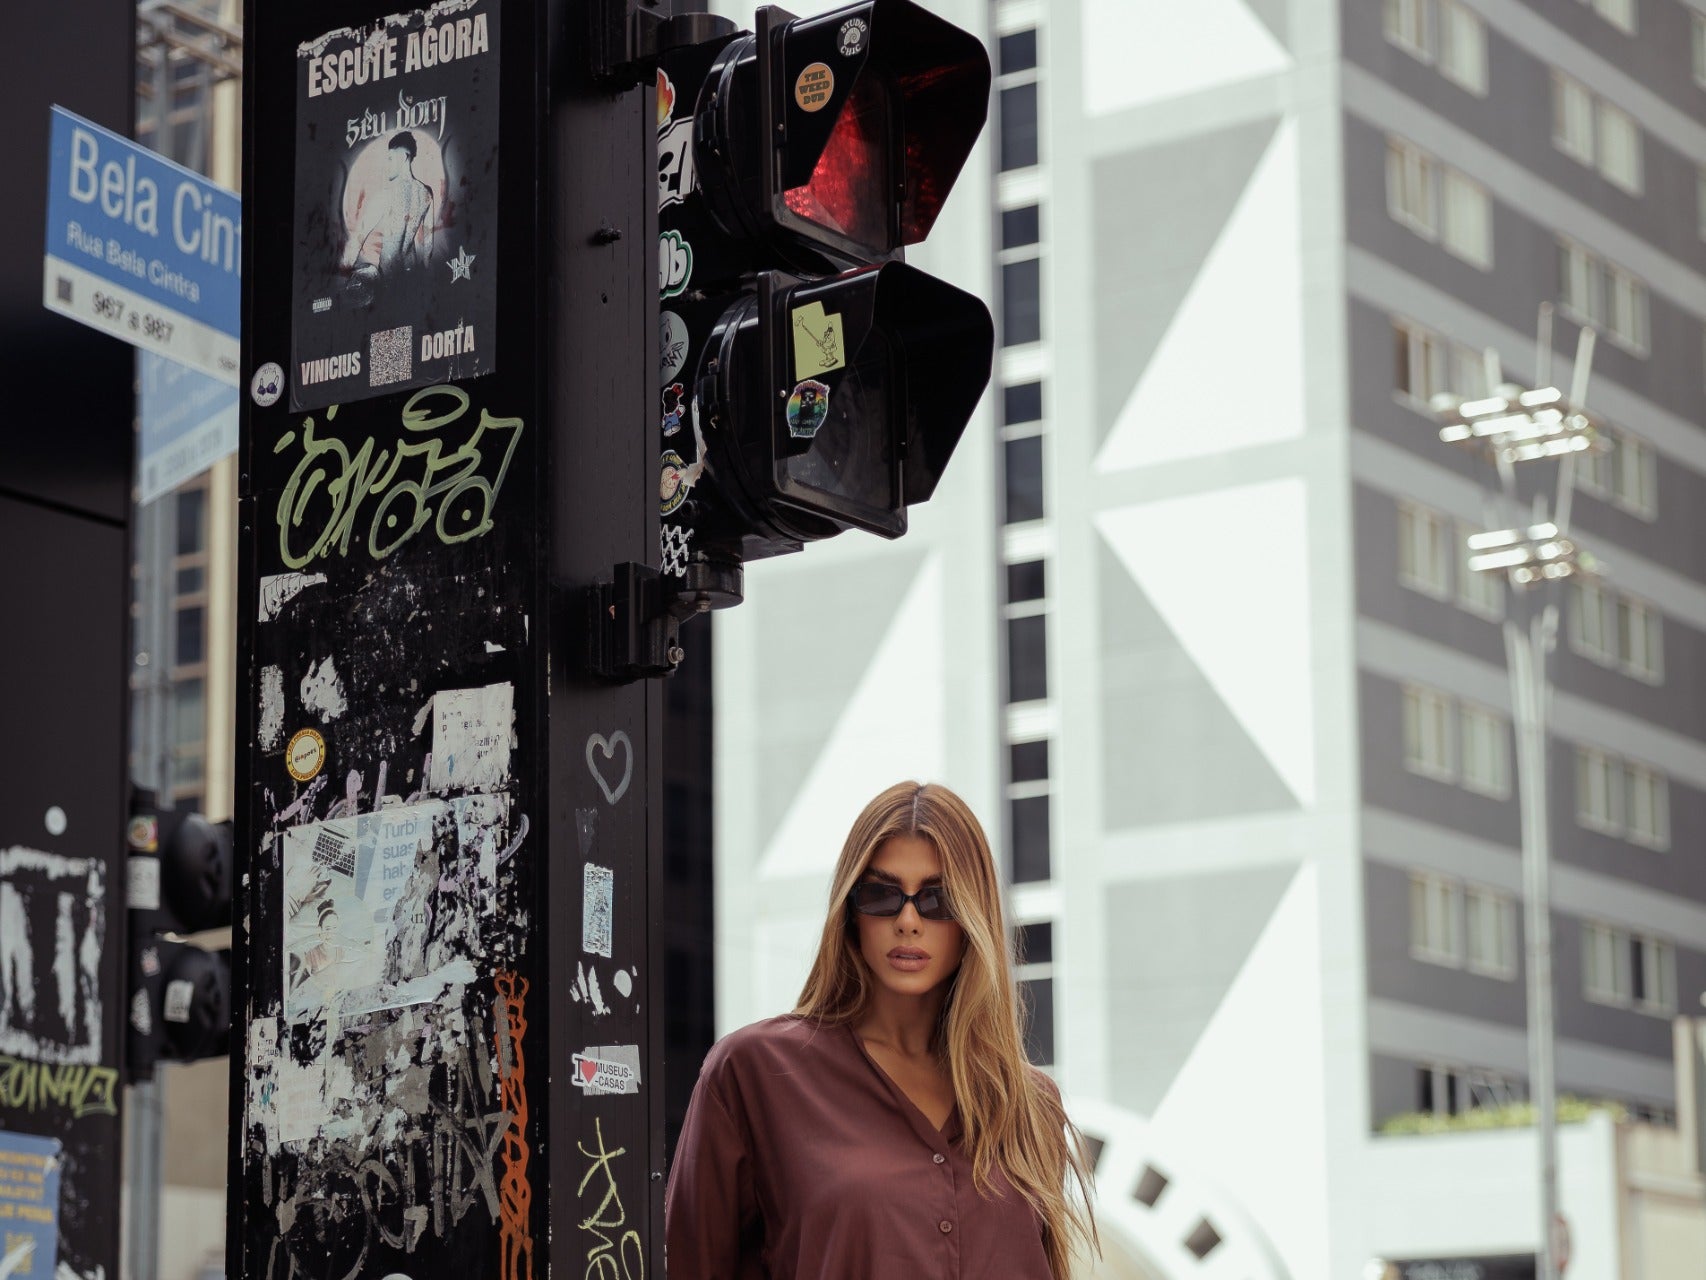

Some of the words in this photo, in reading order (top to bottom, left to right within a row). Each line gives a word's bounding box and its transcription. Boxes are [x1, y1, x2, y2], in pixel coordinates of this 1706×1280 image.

[840, 18, 867, 34] STUDIO
[308, 38, 397, 98] ESCUTE
[404, 12, 489, 74] AGORA
[840, 43, 861, 56] CHIC
[798, 80, 830, 95] WEED
[804, 69, 826, 83] THE
[69, 126, 158, 238] Bela
[172, 180, 241, 276] Cin
[66, 220, 104, 259] Rua
[105, 237, 146, 279] Bela
[148, 258, 200, 302] Cintra
[301, 351, 361, 386] VINICIUS
[421, 325, 475, 362] DORTA
